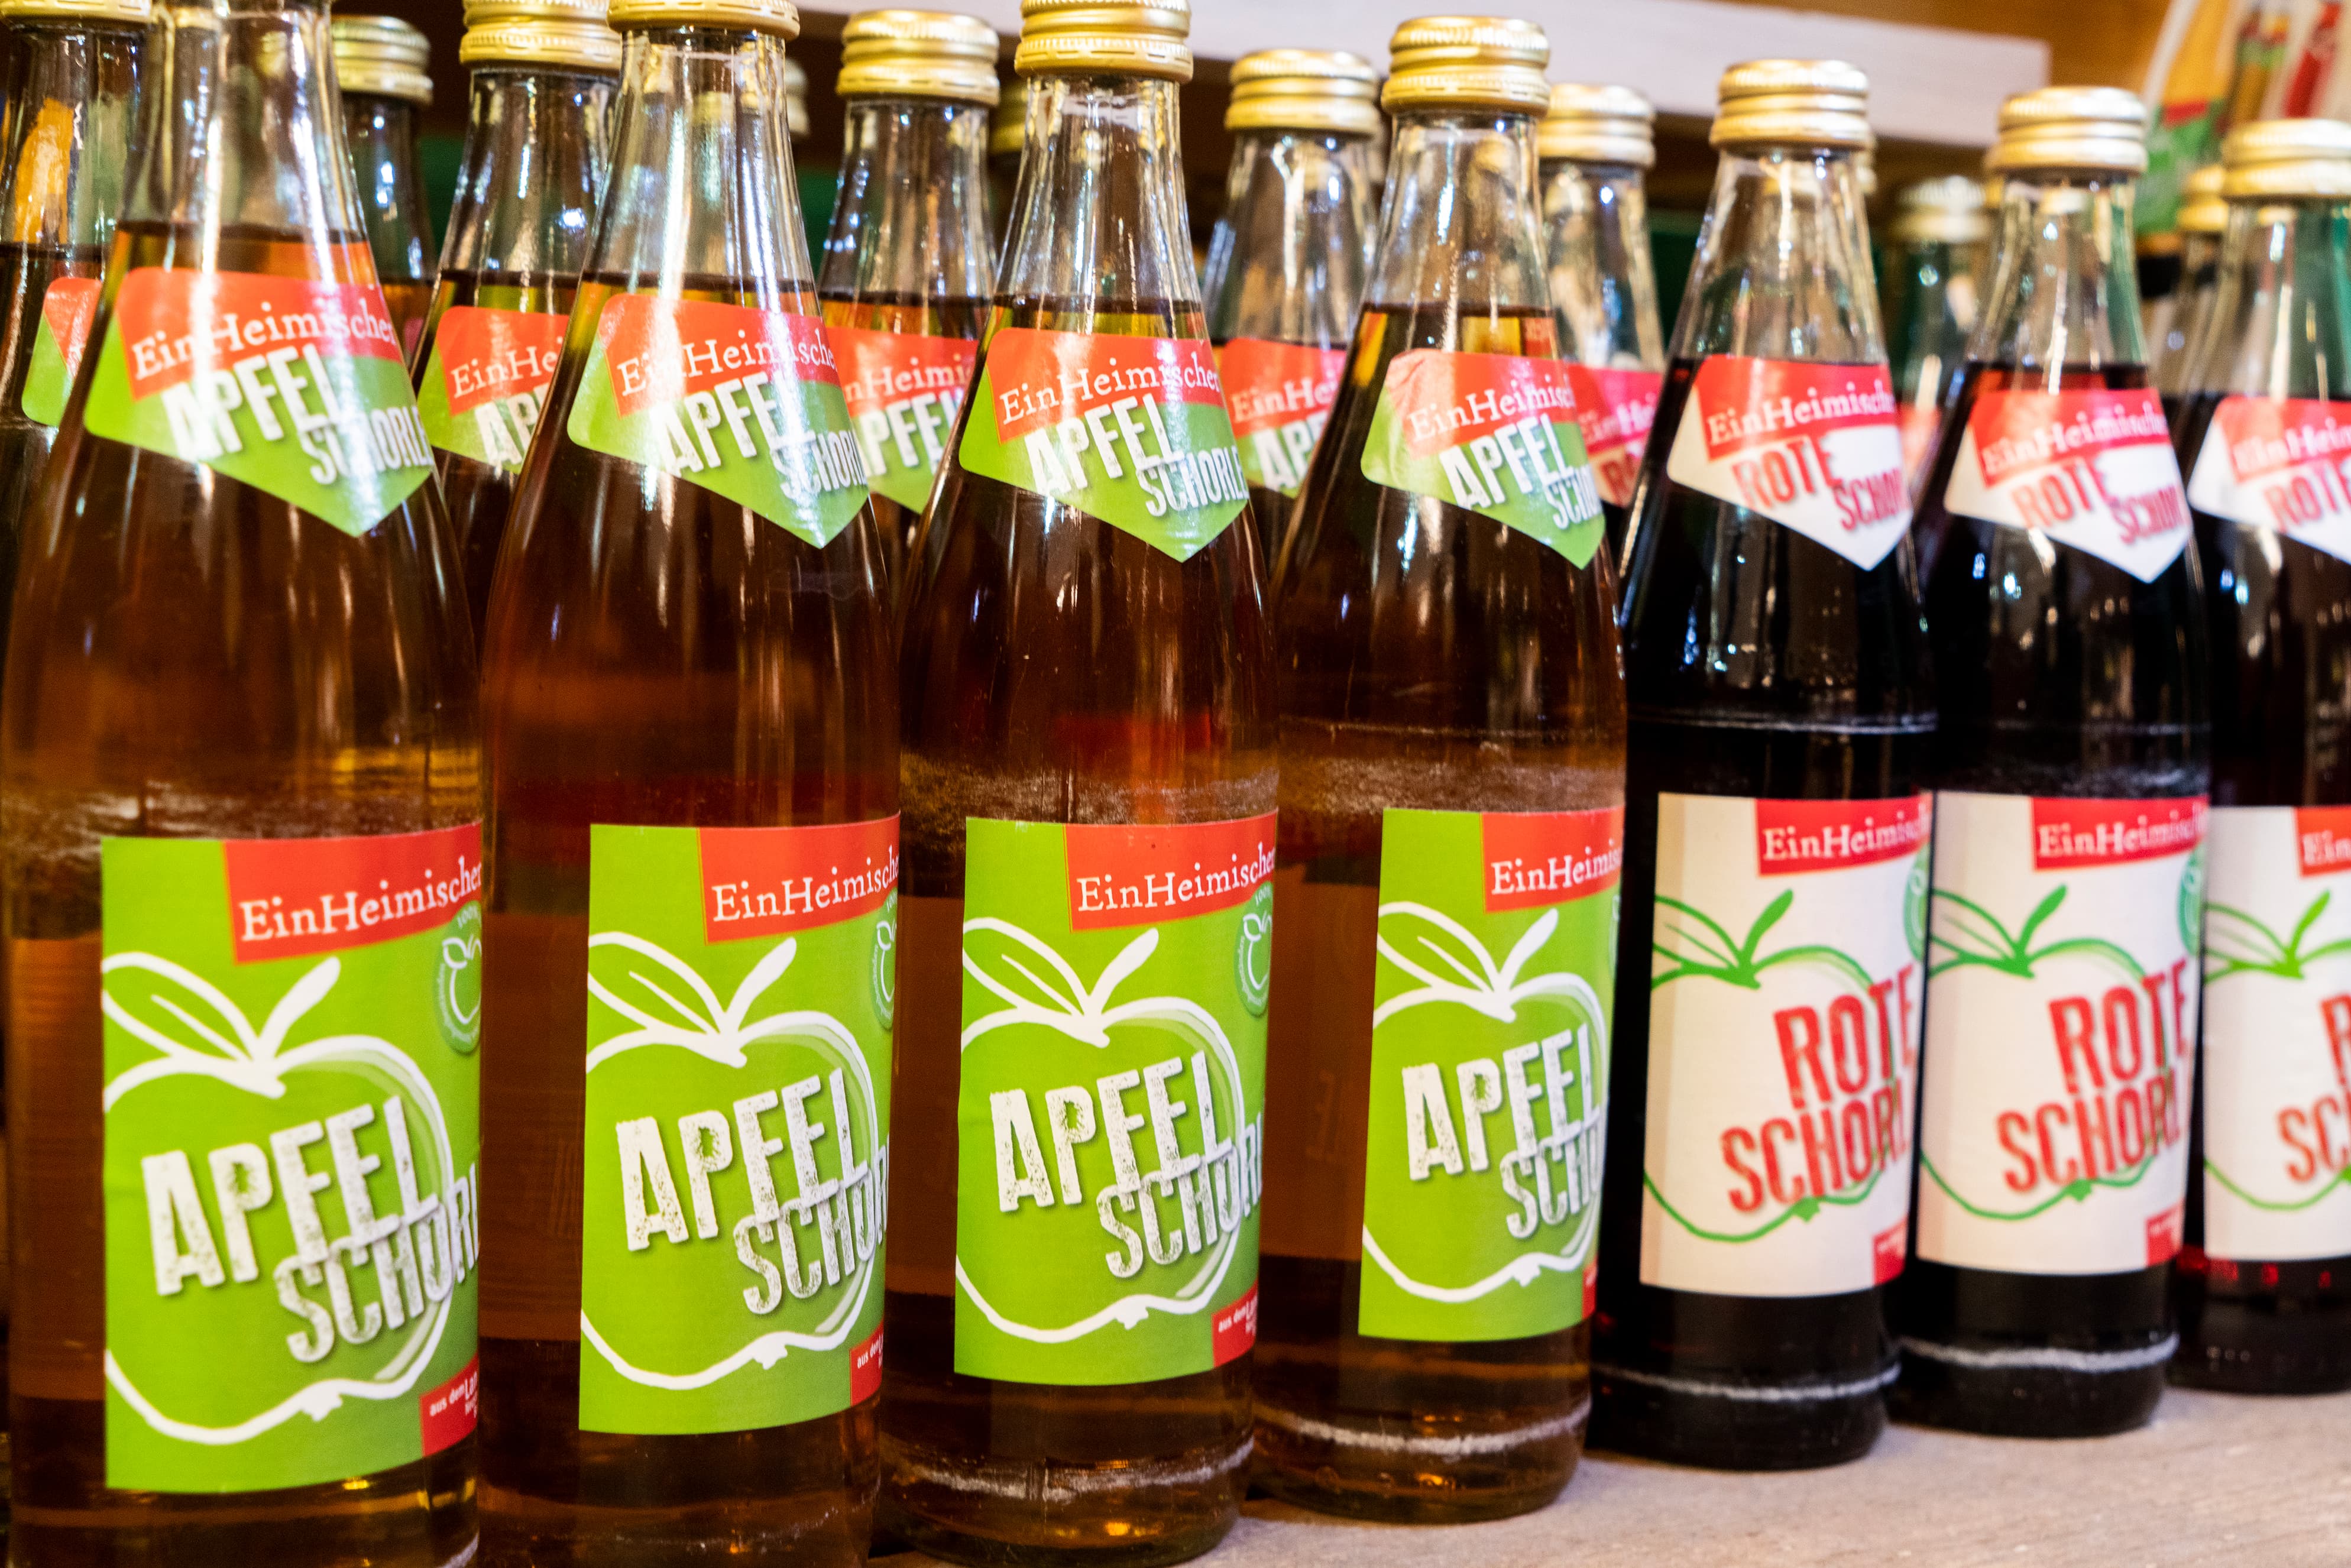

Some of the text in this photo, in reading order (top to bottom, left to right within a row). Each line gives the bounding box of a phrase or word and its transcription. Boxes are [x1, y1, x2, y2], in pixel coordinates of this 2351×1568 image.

[161, 343, 345, 462] APFEL
[653, 367, 817, 475] APFEL
[1024, 393, 1185, 497] APFEL
[1439, 413, 1574, 512] APFEL
[1731, 430, 1844, 511] ROTE
[239, 855, 481, 942] EinHeimischer
[1773, 963, 1918, 1110] ROTE
[2048, 958, 2188, 1096] ROTE
[616, 1067, 868, 1252] APFEL
[990, 1049, 1233, 1213] APFEL
[1401, 1023, 1601, 1182] APFEL
[141, 1096, 439, 1296] APFEL
